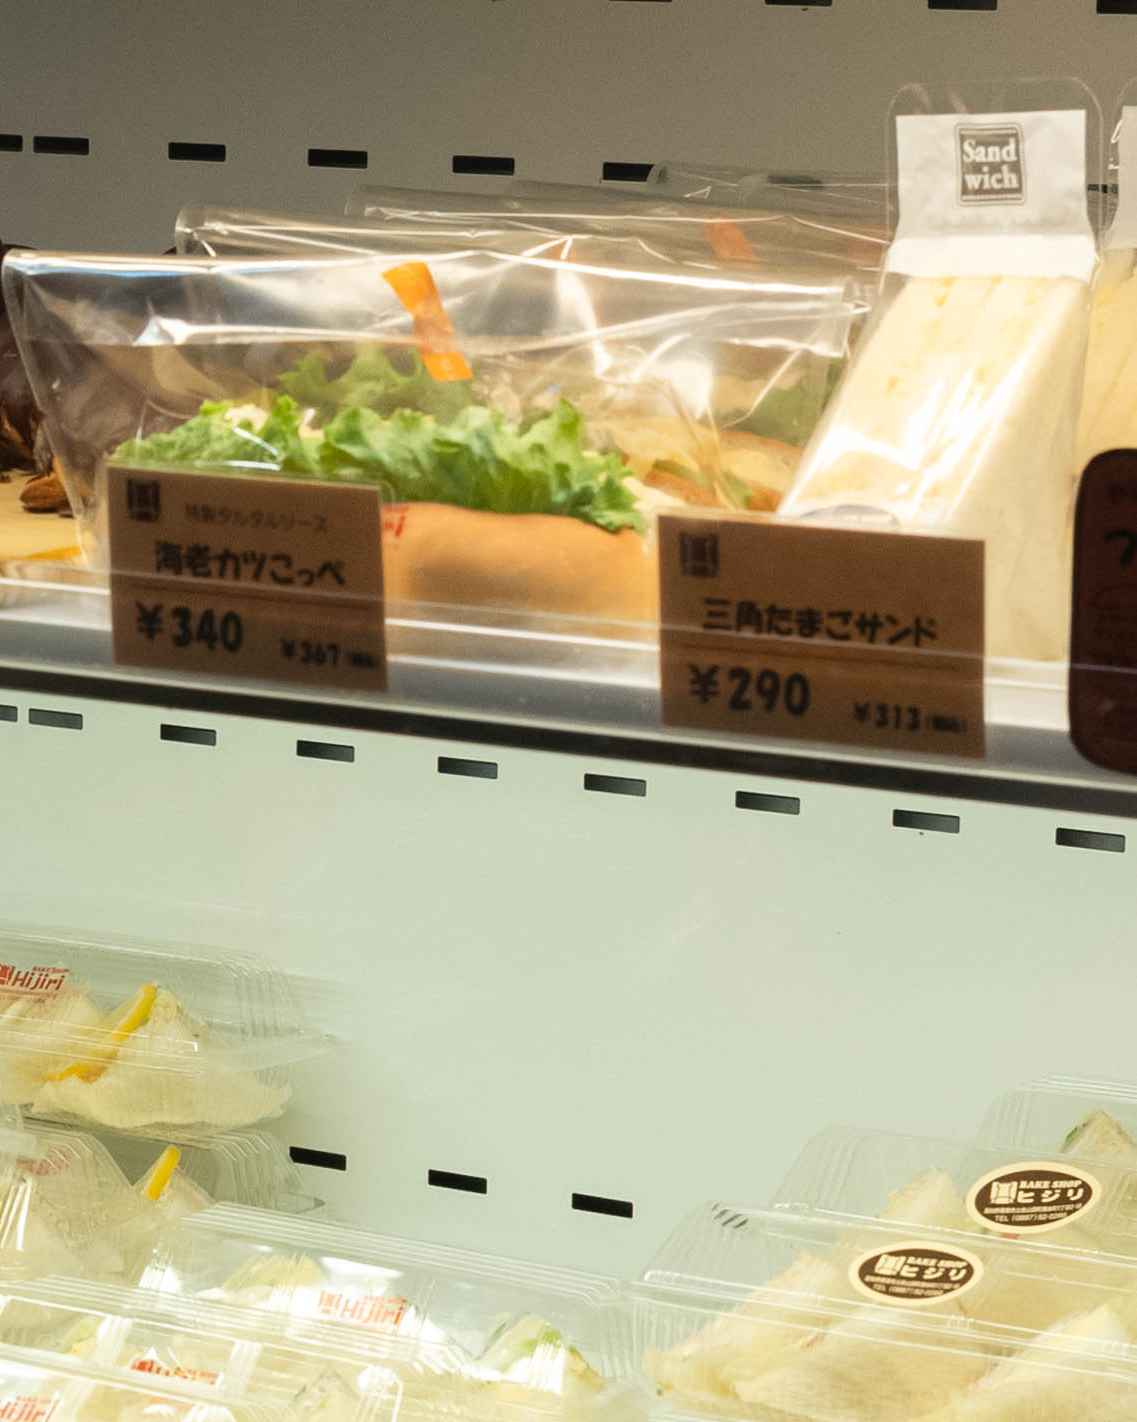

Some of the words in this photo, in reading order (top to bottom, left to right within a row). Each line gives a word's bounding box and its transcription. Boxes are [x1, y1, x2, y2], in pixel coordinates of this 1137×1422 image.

[962, 138, 1018, 163] Sand
[964, 164, 1019, 189] wich
[136, 602, 243, 653] ¥340
[702, 597, 937, 647] 三角たまごサンド
[688, 663, 810, 716] ¥290
[12, 970, 65, 990] Hijiri
[1017, 1188, 1084, 1203] ヒジリ
[1019, 1181, 1050, 1189] BAKE
[900, 1264, 967, 1281] ヒジリ
